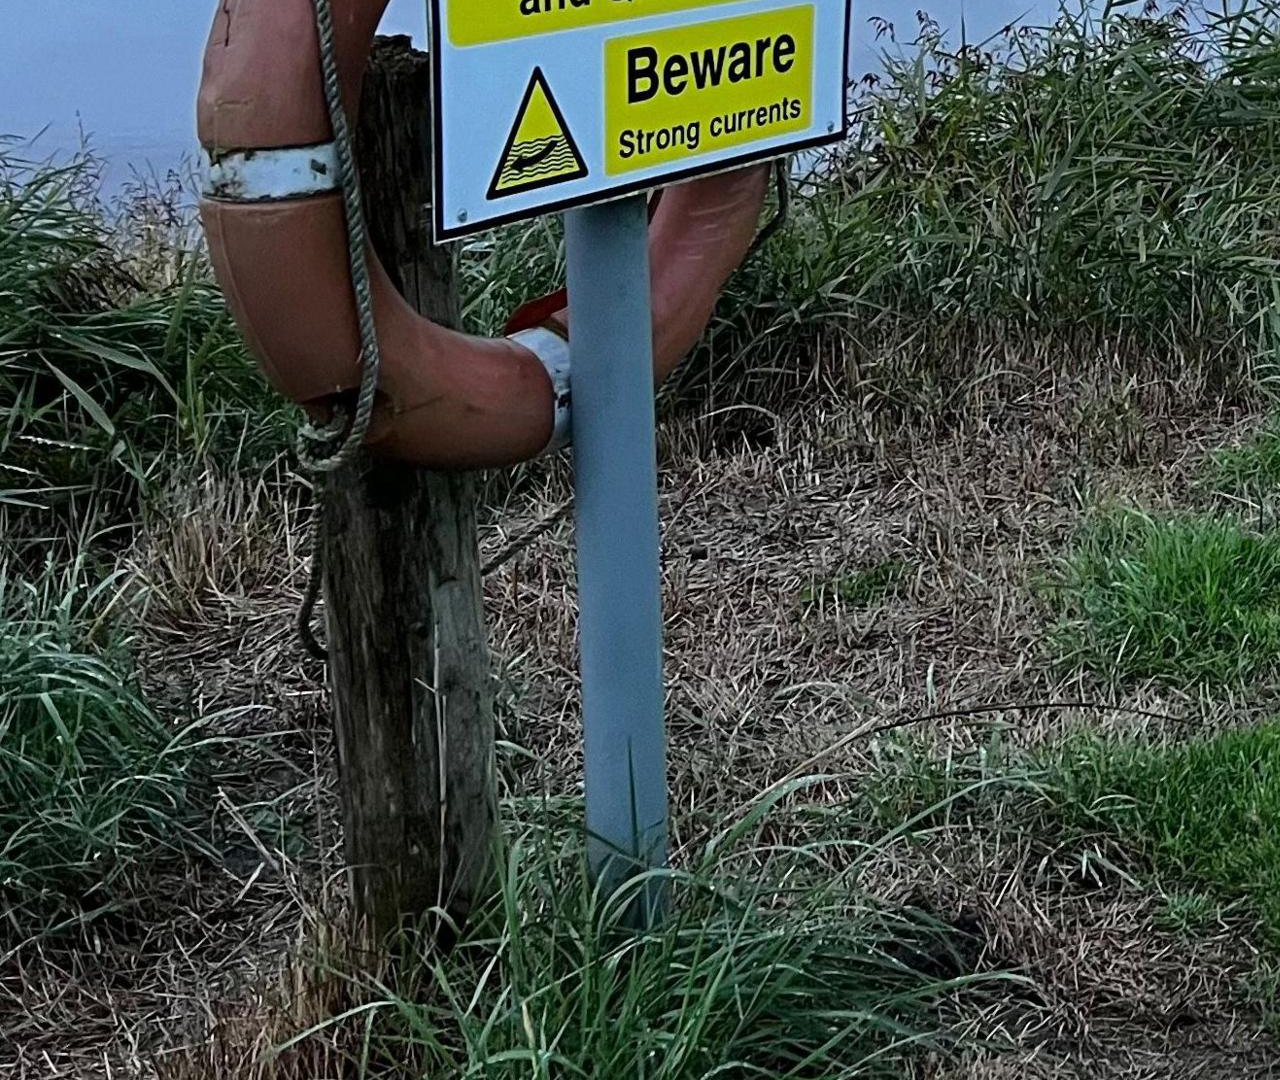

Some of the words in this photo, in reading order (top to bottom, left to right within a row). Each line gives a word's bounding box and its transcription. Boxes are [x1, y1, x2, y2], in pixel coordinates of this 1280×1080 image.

[627, 33, 796, 105] Beware
[619, 121, 700, 159] Strong
[709, 97, 801, 137] currents
